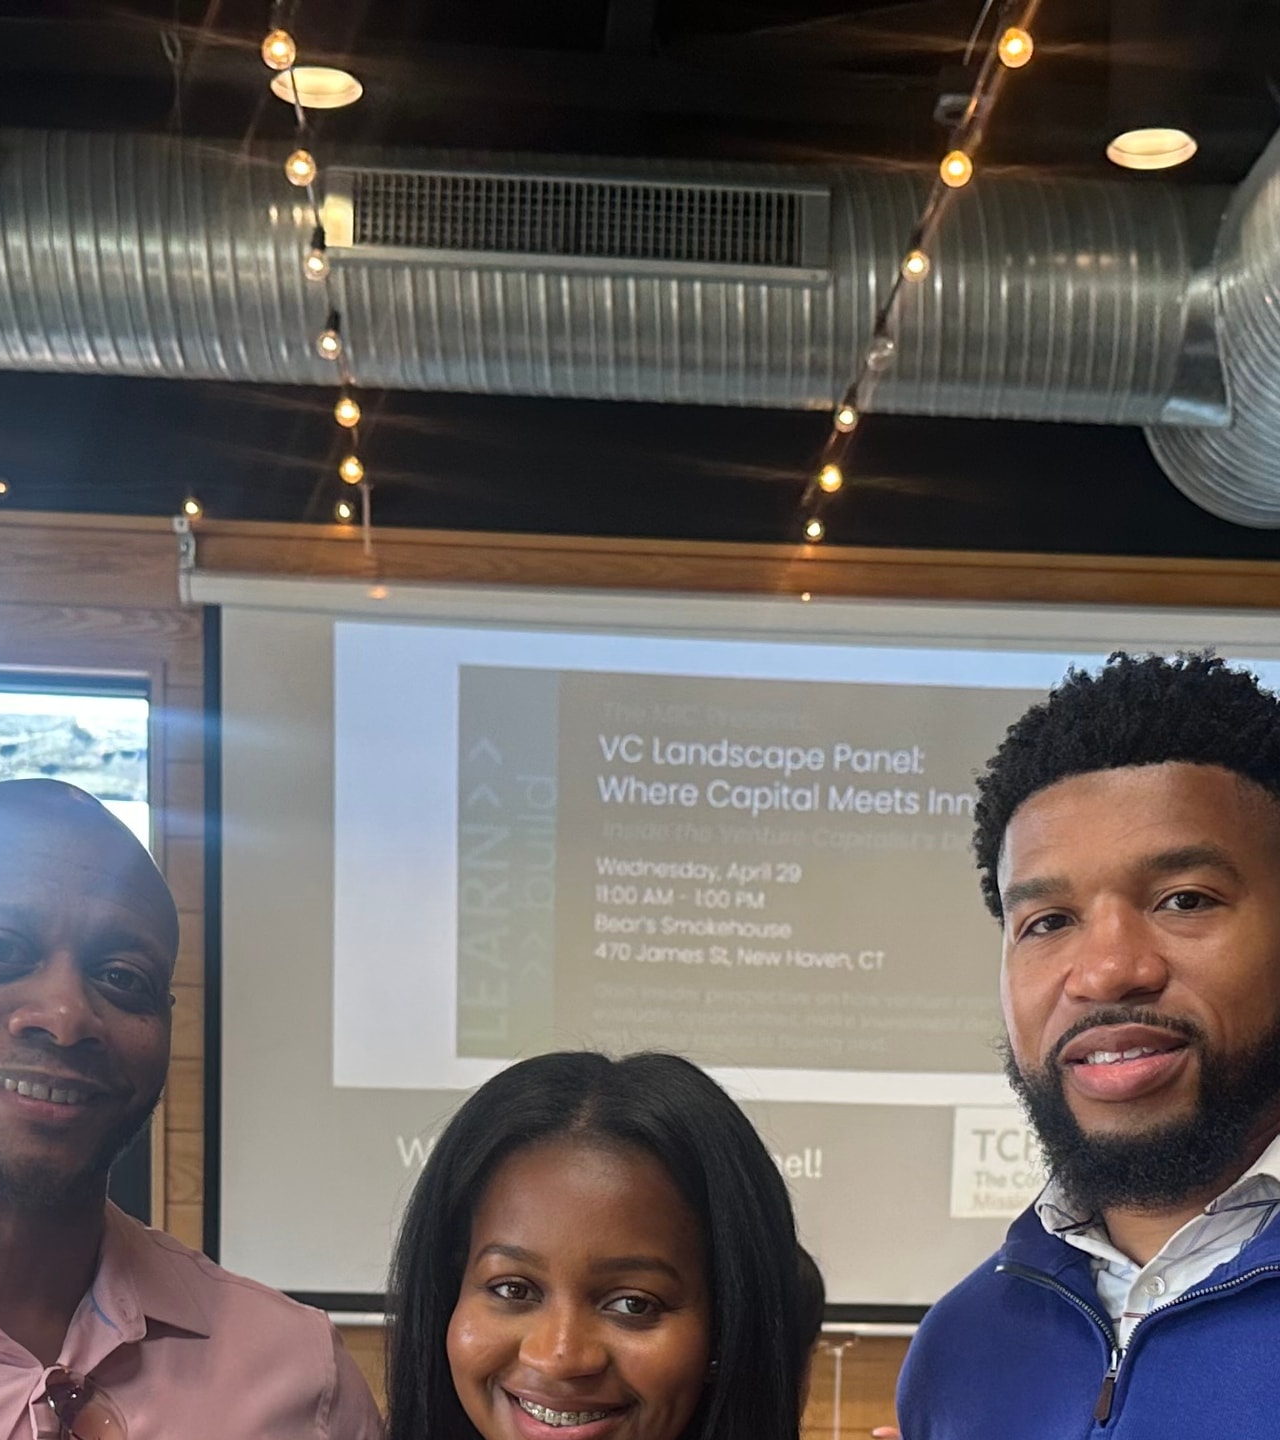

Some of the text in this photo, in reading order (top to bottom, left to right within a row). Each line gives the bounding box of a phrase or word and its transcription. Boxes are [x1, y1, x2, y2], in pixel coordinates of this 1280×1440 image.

[598, 733, 926, 777] VC Landscape Panel:
[597, 775, 976, 817] Where Capital Meets Inn
[596, 856, 803, 886] Wednesday, April 29
[595, 884, 638, 905] 11:00
[642, 887, 674, 906] AM
[694, 887, 730, 909] 1:00
[735, 891, 766, 910] PM
[594, 912, 793, 940] Bear's Smokehouse
[594, 941, 631, 962] 470
[636, 943, 704, 965] James
[737, 947, 781, 967] New
[786, 948, 854, 971] Haven,
[858, 950, 885, 971] CT
[397, 1135, 823, 1178] W el!
